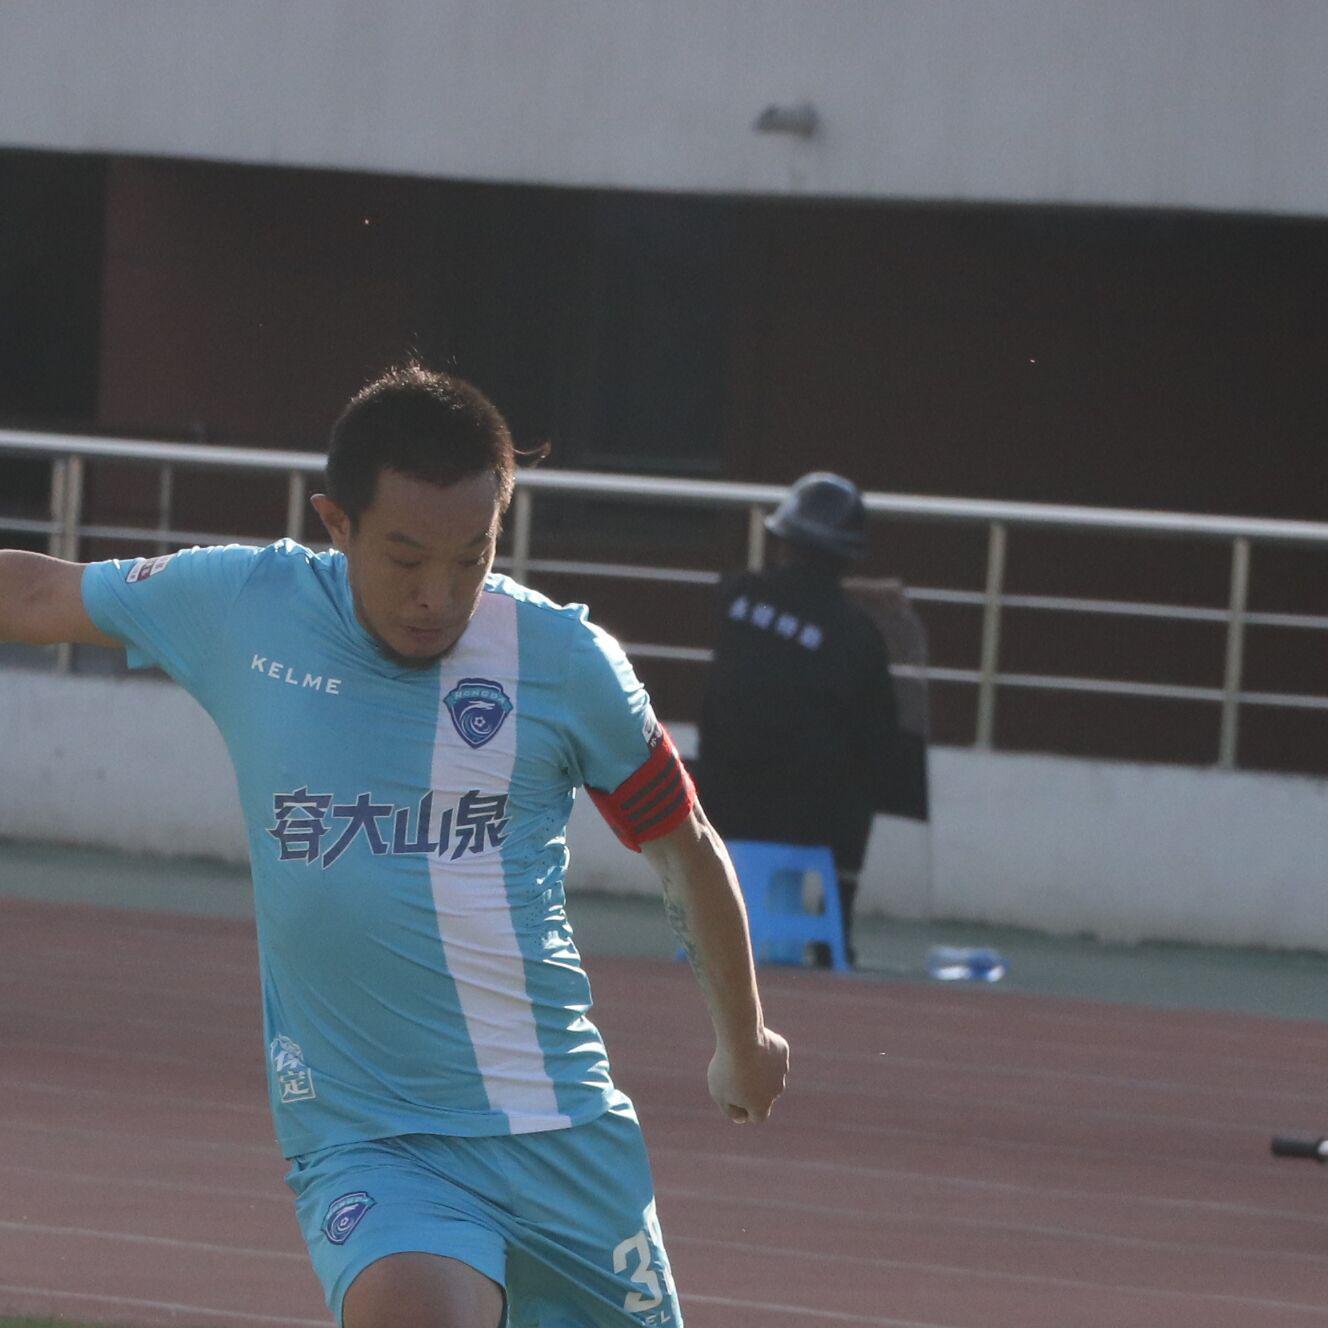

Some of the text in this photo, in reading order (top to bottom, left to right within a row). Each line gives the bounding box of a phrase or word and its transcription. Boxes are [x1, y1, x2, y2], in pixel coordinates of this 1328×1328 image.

[251, 654, 342, 695] KELME
[265, 785, 512, 869] 容大山泉
